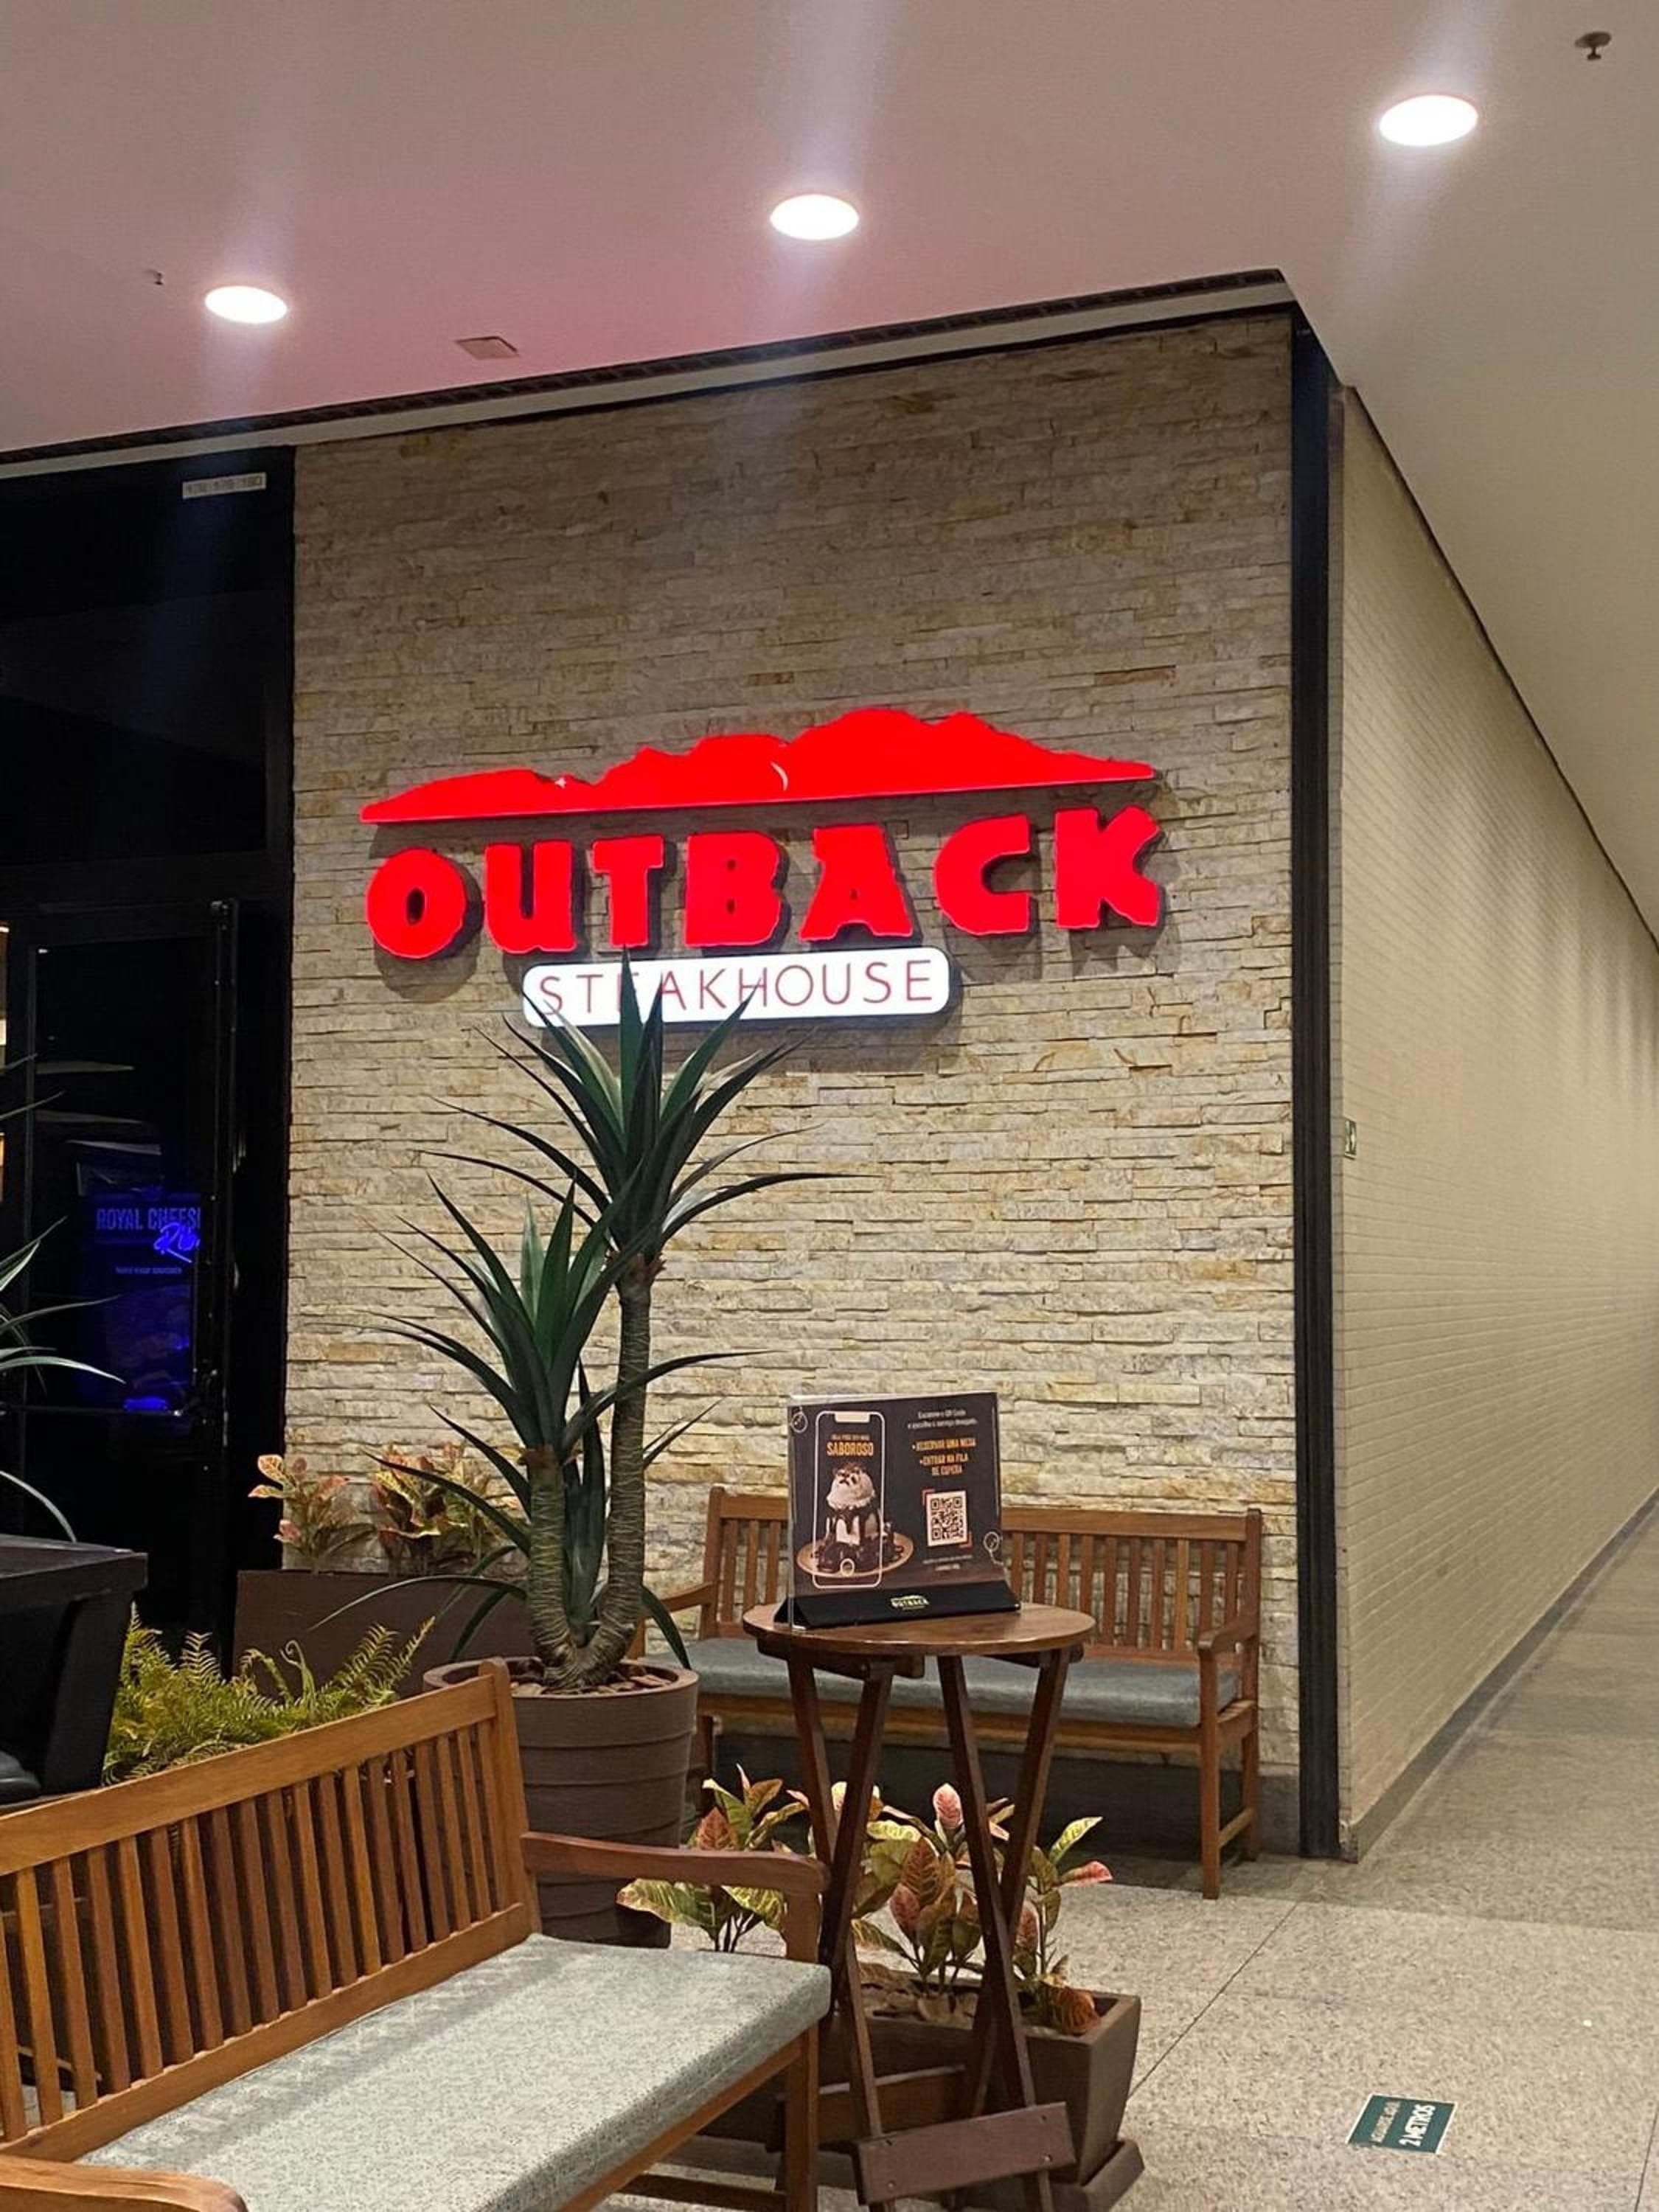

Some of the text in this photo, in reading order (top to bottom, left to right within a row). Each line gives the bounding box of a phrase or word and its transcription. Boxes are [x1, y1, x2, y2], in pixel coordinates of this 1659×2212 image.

[365, 805, 1161, 959] OUTBACK
[96, 1207, 144, 1231] ROYAL
[827, 1441, 874, 1456] SABOROSO
[1398, 2104, 1436, 2146] 2 METROS
